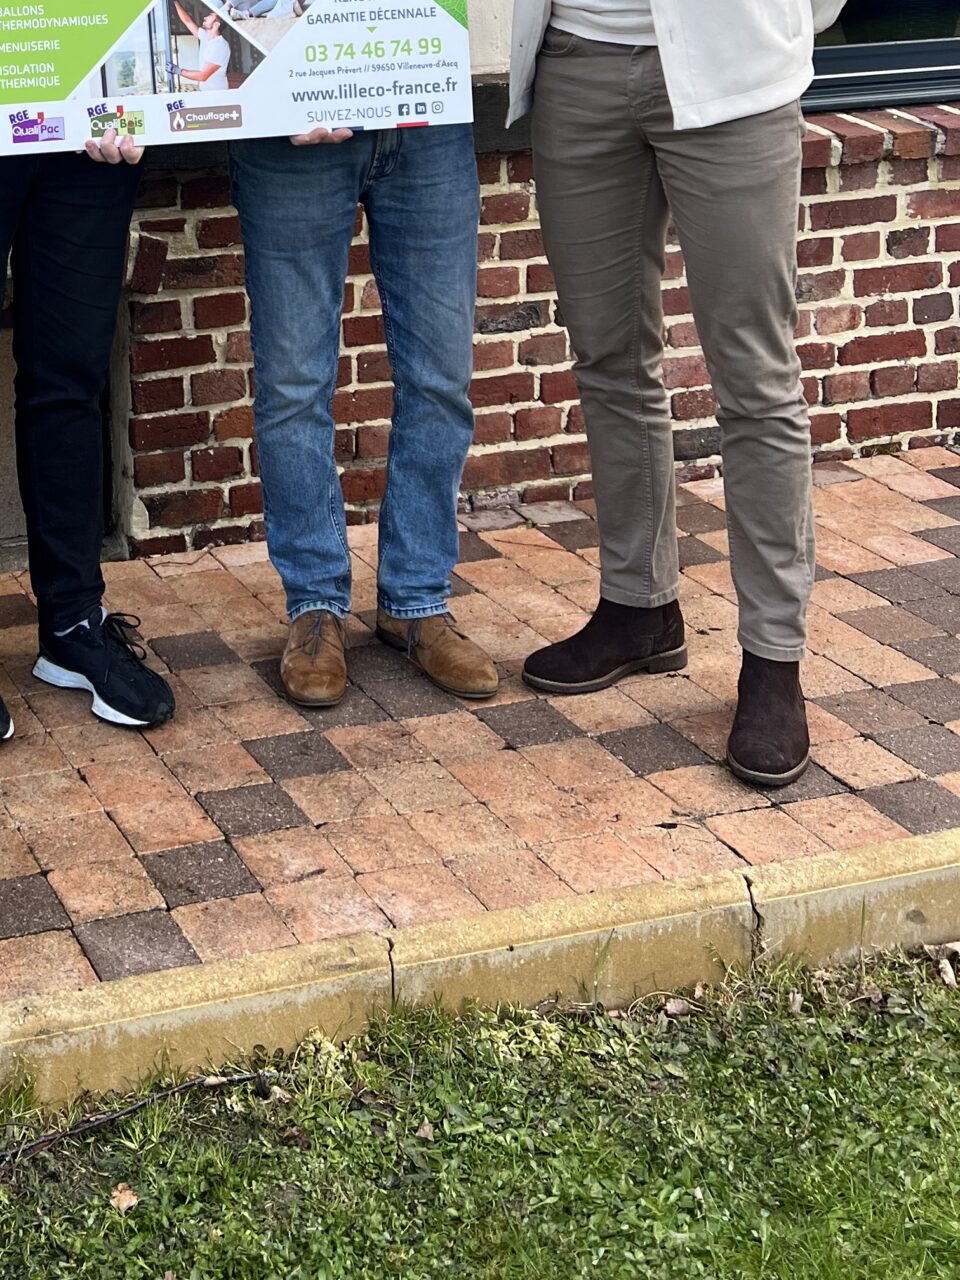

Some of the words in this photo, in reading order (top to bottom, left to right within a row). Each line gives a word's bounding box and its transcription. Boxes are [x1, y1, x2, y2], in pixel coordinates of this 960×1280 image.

[307, 11, 367, 25] GARANTIE
[369, 7, 437, 21] DÉCENNALE
[305, 44, 329, 63] 03
[333, 42, 356, 61] 74
[361, 40, 386, 59] 46
[390, 38, 413, 57] 74
[418, 37, 442, 56] 99
[0, 62, 55, 76] ISOLATION
[288, 69, 294, 78] 2
[308, 68, 336, 78] Jacques
[336, 66, 362, 75] Prévert
[363, 64, 370, 72] //
[371, 62, 395, 72] 59650
[396, 60, 458, 71] Villeneuve-d'Ascq
[0, 75, 61, 89] THERMIQUE
[291, 77, 458, 103] www.lilleco-france.fr
[86, 103, 108, 118] RGE
[166, 99, 185, 112] RGE
[9, 109, 29, 124] RGE
[307, 105, 392, 123] SUIVEZ-NOUS
